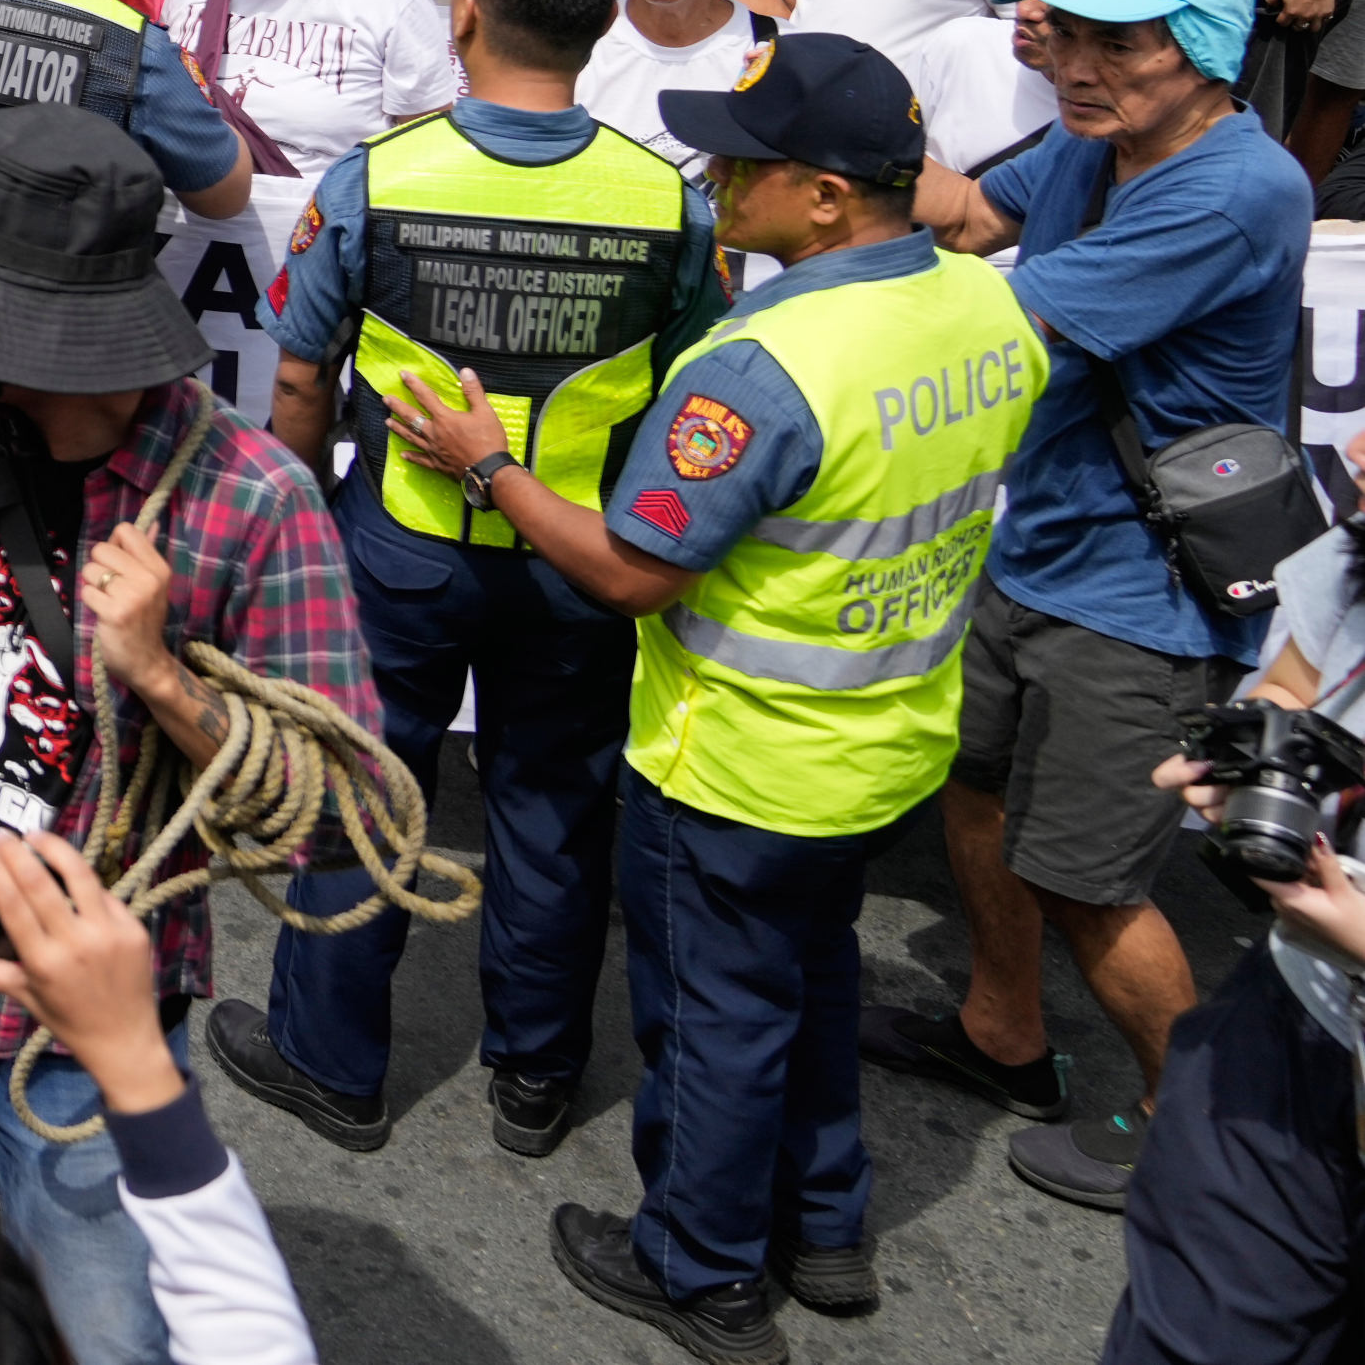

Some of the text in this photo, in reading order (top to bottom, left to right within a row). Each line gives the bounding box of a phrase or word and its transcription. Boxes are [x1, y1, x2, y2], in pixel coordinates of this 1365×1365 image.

[48, 16, 93, 45] POLICE
[399, 222, 650, 263] PHILIPPINE NATIONAL POLICE
[416, 259, 624, 297] MANILA POLICE DISTRICT
[430, 288, 601, 354] LEGAL OFFICER
[873, 340, 1027, 452] POLICE
[836, 545, 977, 634] OFFICER
[844, 554, 929, 595] HUMAN
